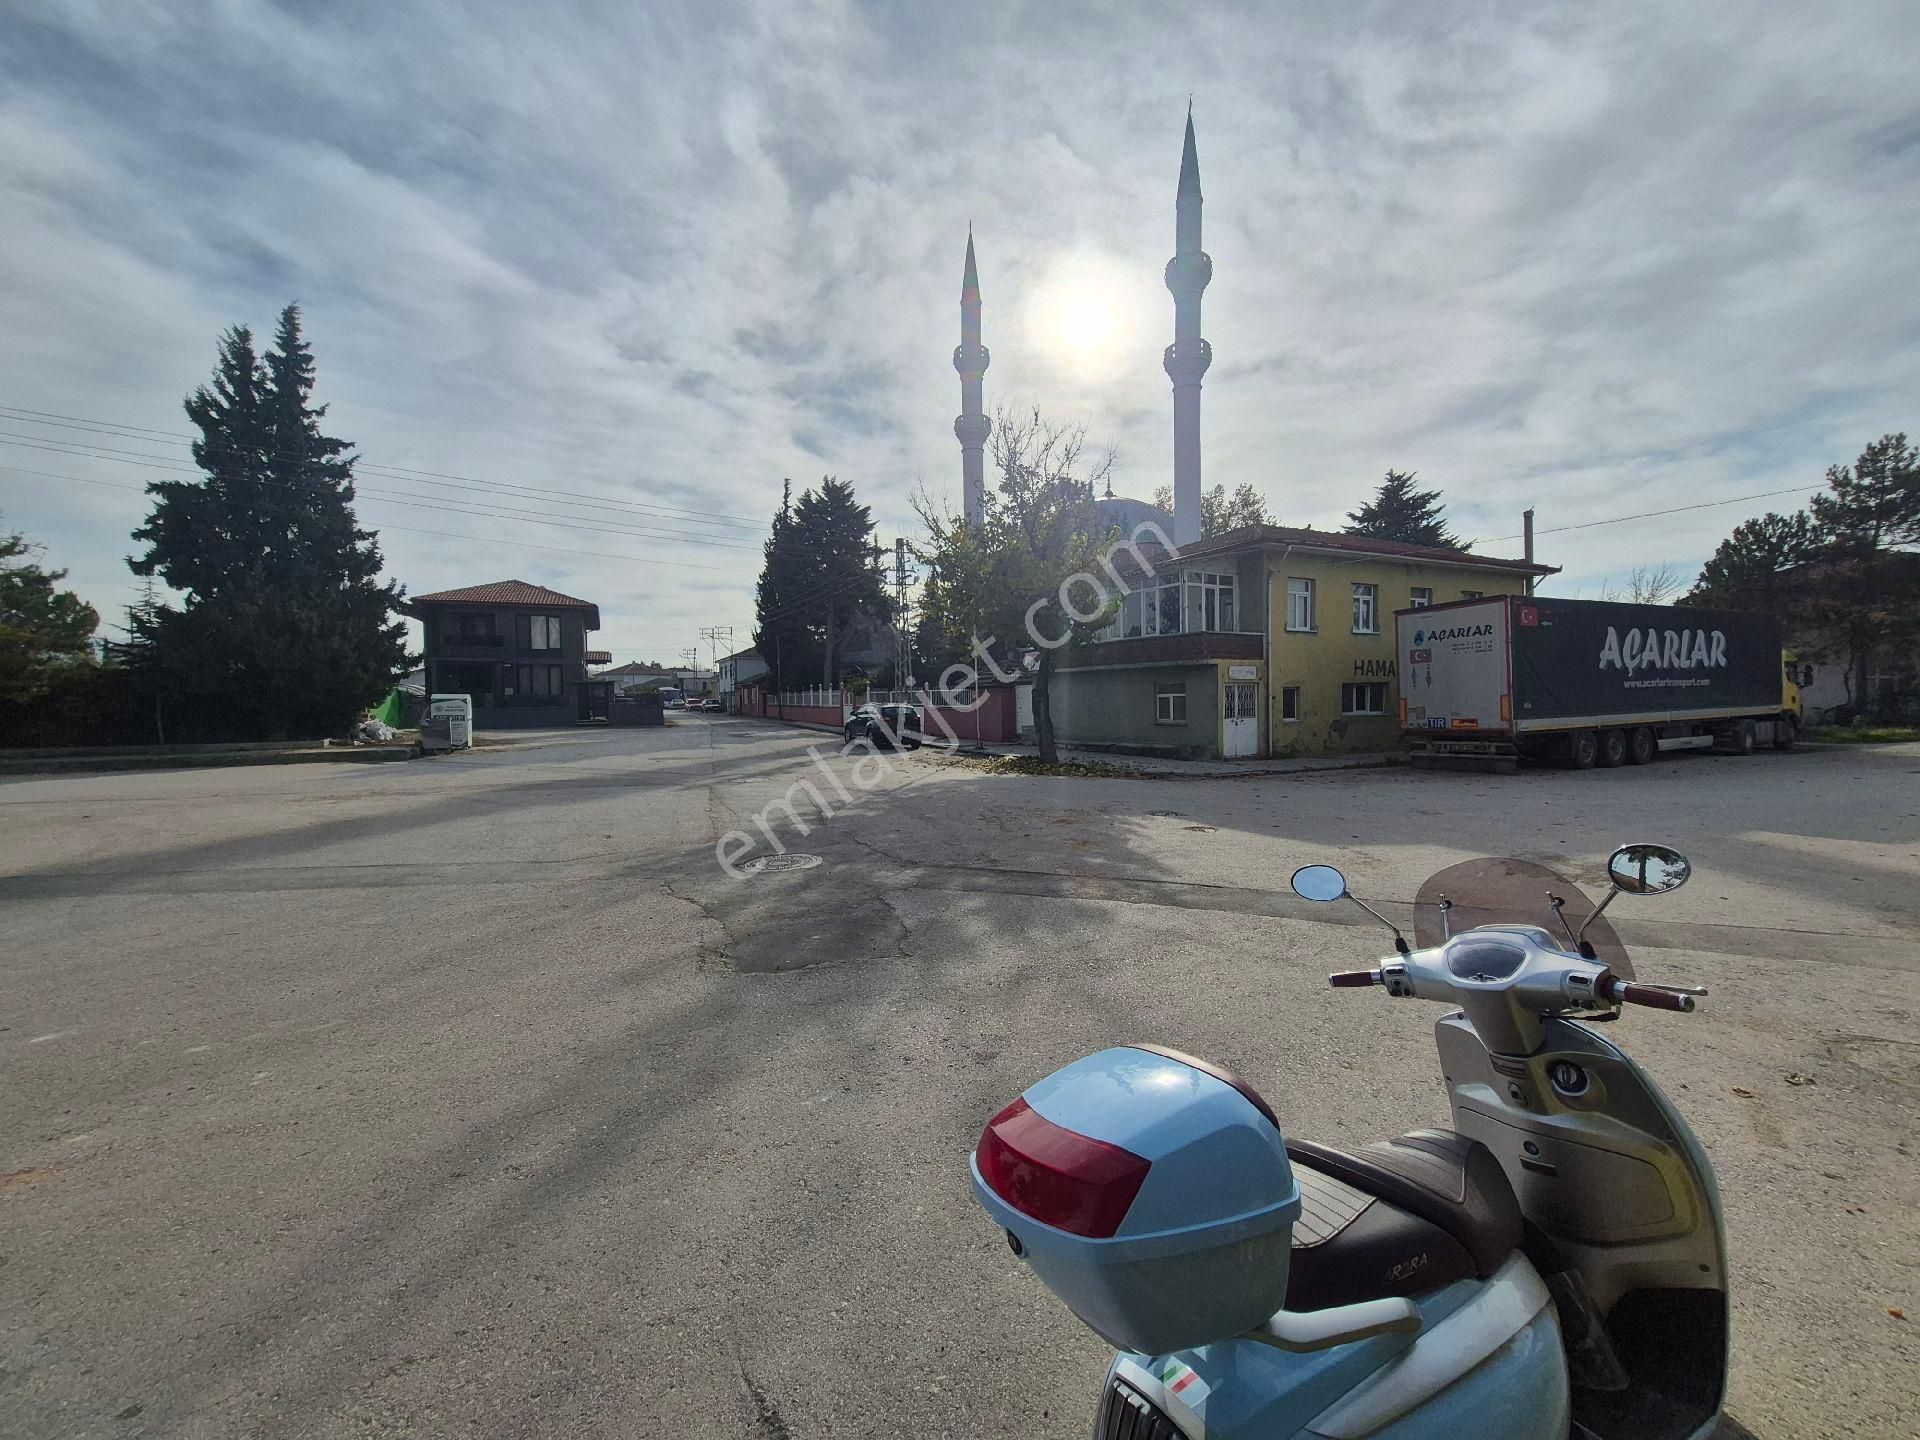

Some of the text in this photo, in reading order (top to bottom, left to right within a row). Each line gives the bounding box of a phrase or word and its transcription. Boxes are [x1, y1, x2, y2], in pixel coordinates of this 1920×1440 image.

[1428, 624, 1493, 642] AÇARLAR
[1598, 626, 1727, 677] AÇARLAR
[1428, 718, 1445, 728] TIR
